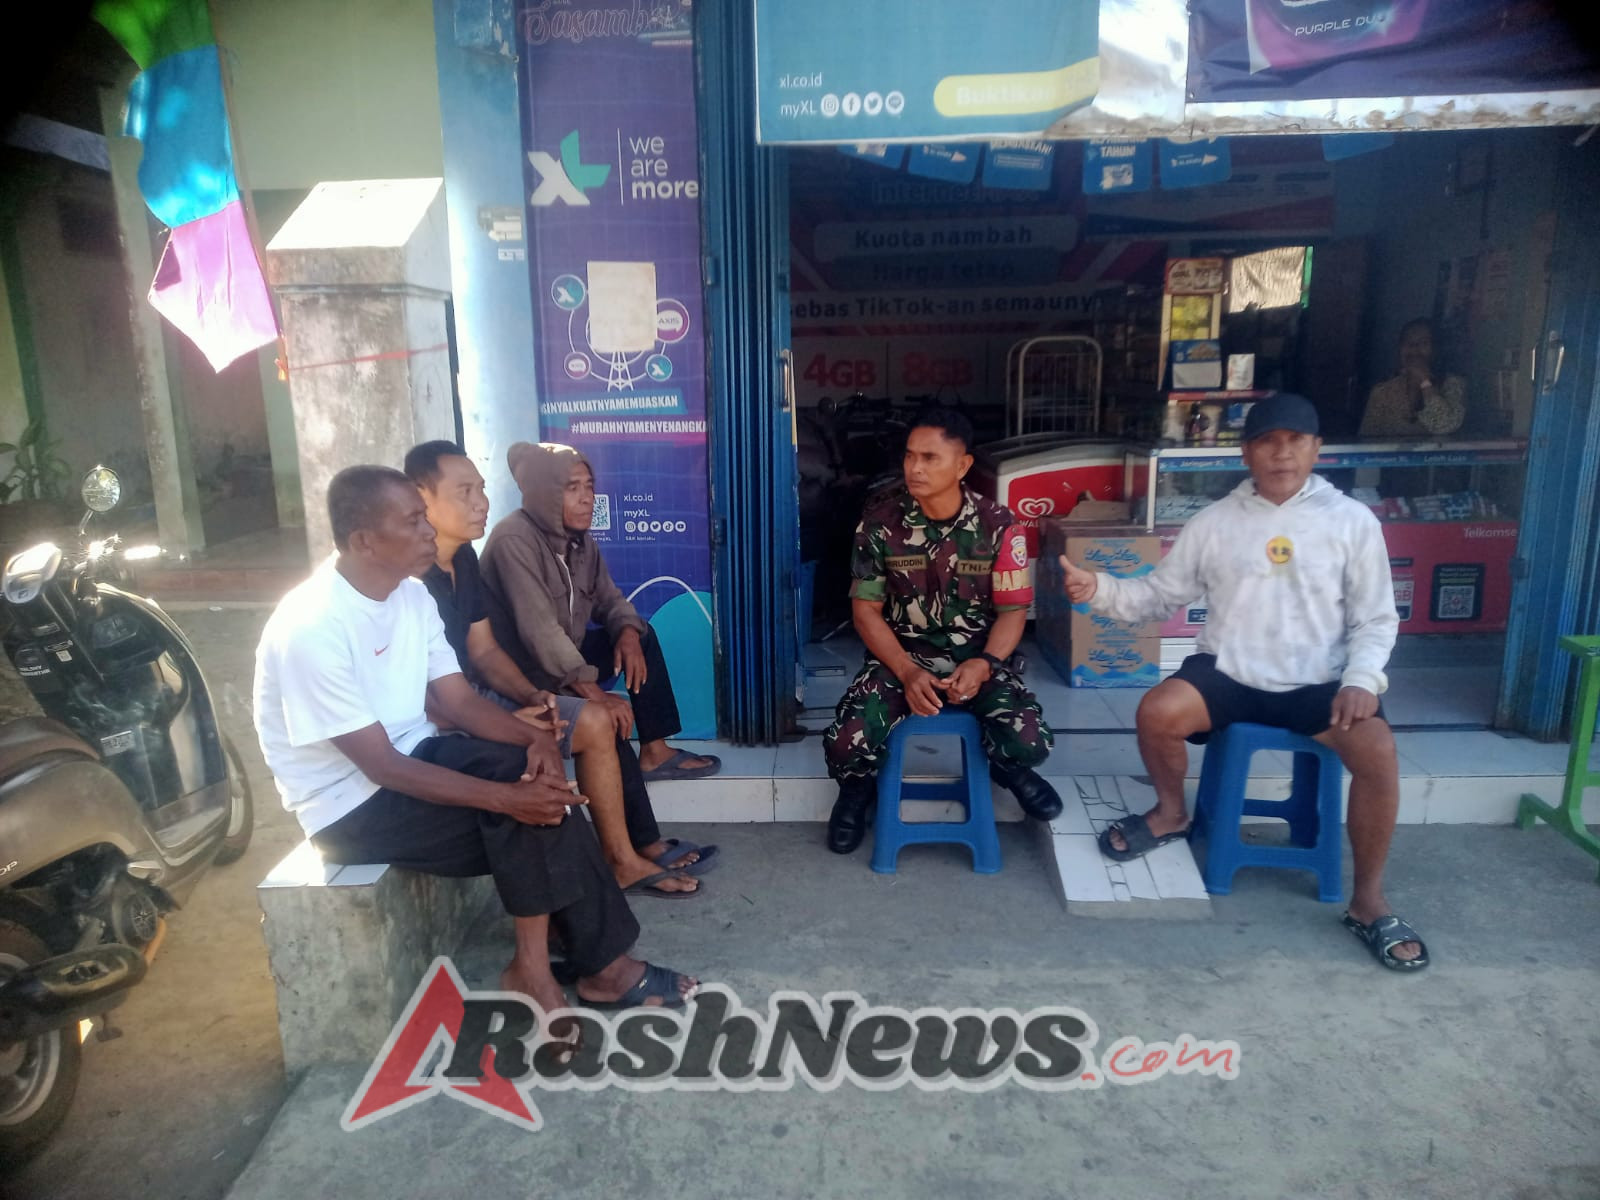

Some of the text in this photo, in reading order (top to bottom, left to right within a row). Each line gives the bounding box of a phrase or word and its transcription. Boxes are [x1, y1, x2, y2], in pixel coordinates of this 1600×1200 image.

[1294, 19, 1352, 37] PURPLE
[779, 72, 823, 88] xl.co.id
[780, 100, 818, 117] myXL
[629, 136, 665, 154] we
[527, 128, 612, 206] XL
[631, 158, 668, 177] are
[631, 180, 699, 199] more
[855, 225, 1033, 249] Kuota nambah
[790, 289, 1101, 319] ebas TikTok-an semauny
[802, 352, 877, 389] 4GB
[902, 351, 975, 389] 8GB
[623, 494, 654, 502] xl.co.id
[624, 509, 650, 518] myXL
[1463, 527, 1518, 539] Telkomse
